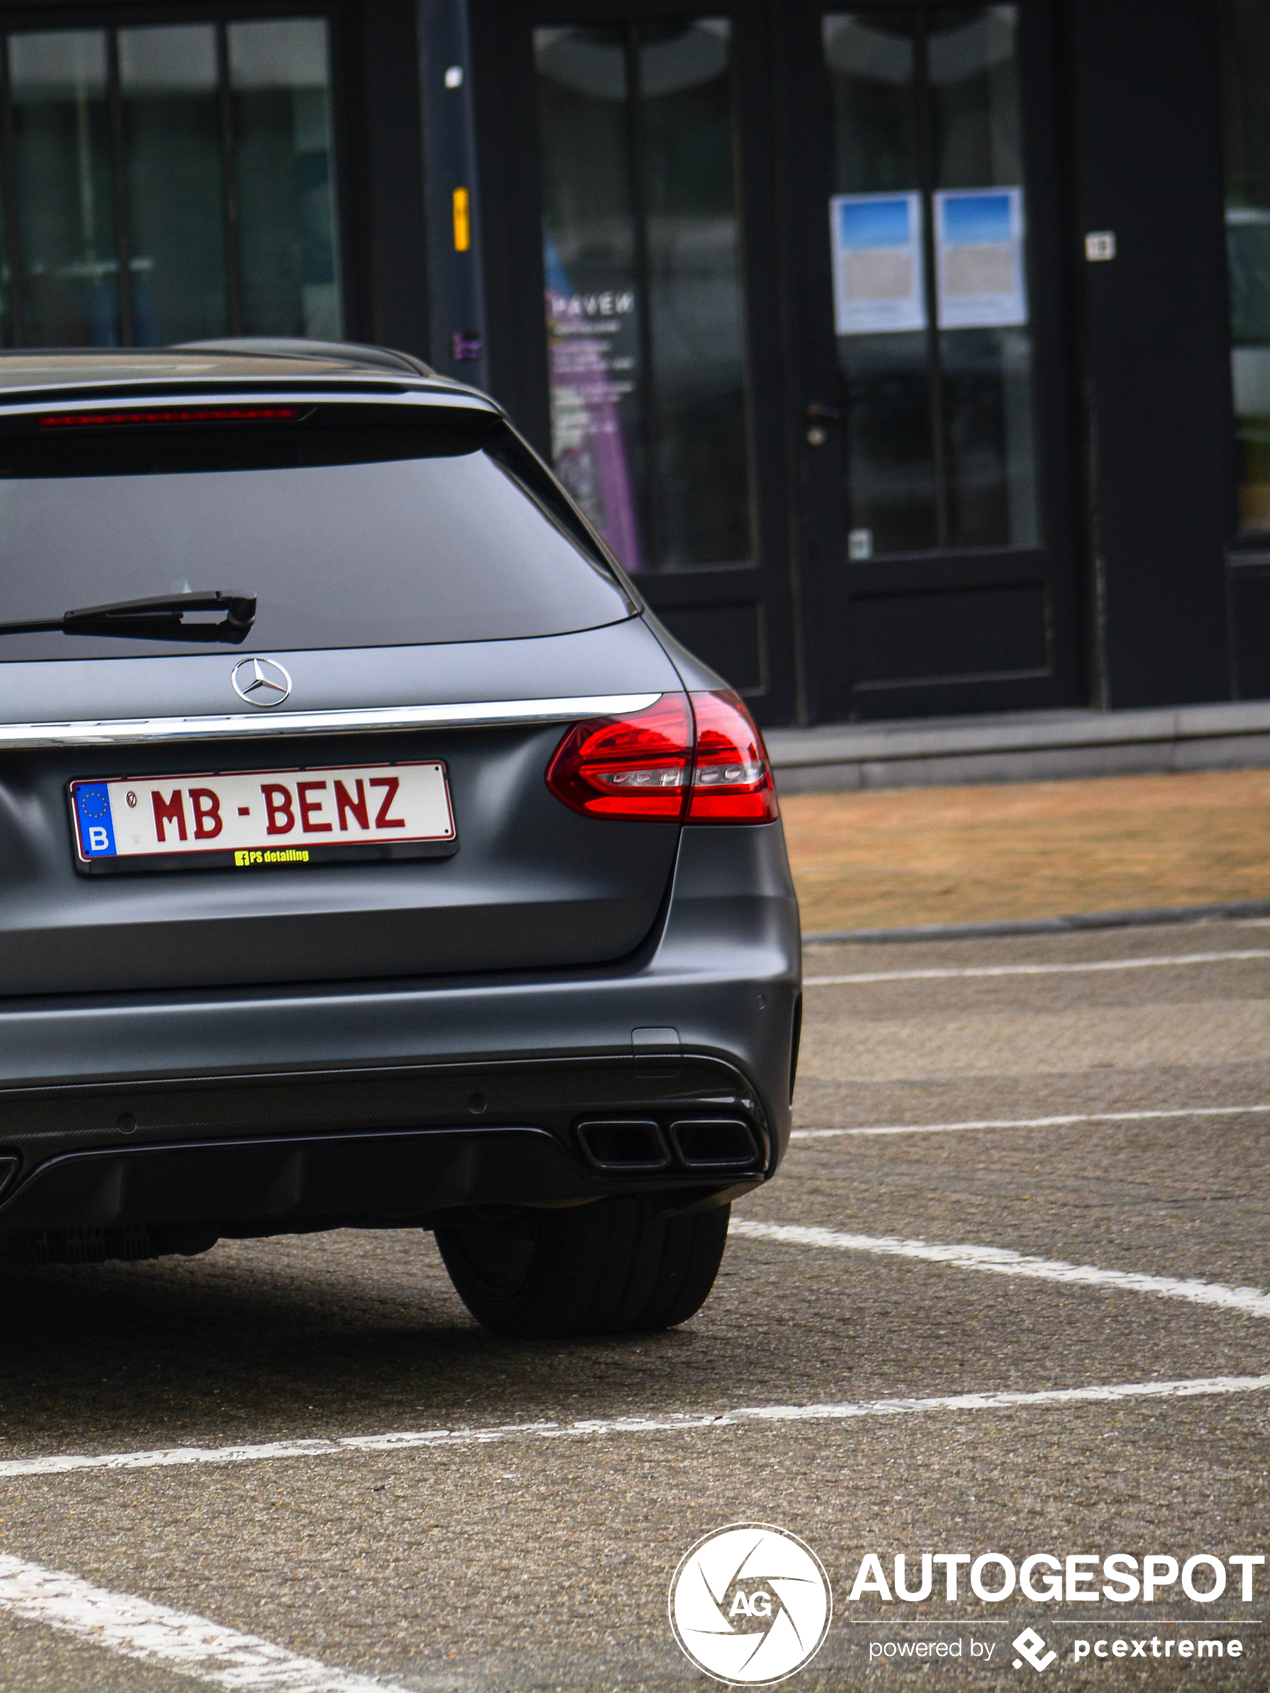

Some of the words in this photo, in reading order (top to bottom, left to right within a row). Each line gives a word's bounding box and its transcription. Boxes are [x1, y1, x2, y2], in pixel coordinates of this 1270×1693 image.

[88, 826, 109, 851] B
[249, 851, 263, 863] PS
[263, 849, 309, 863] detailing
